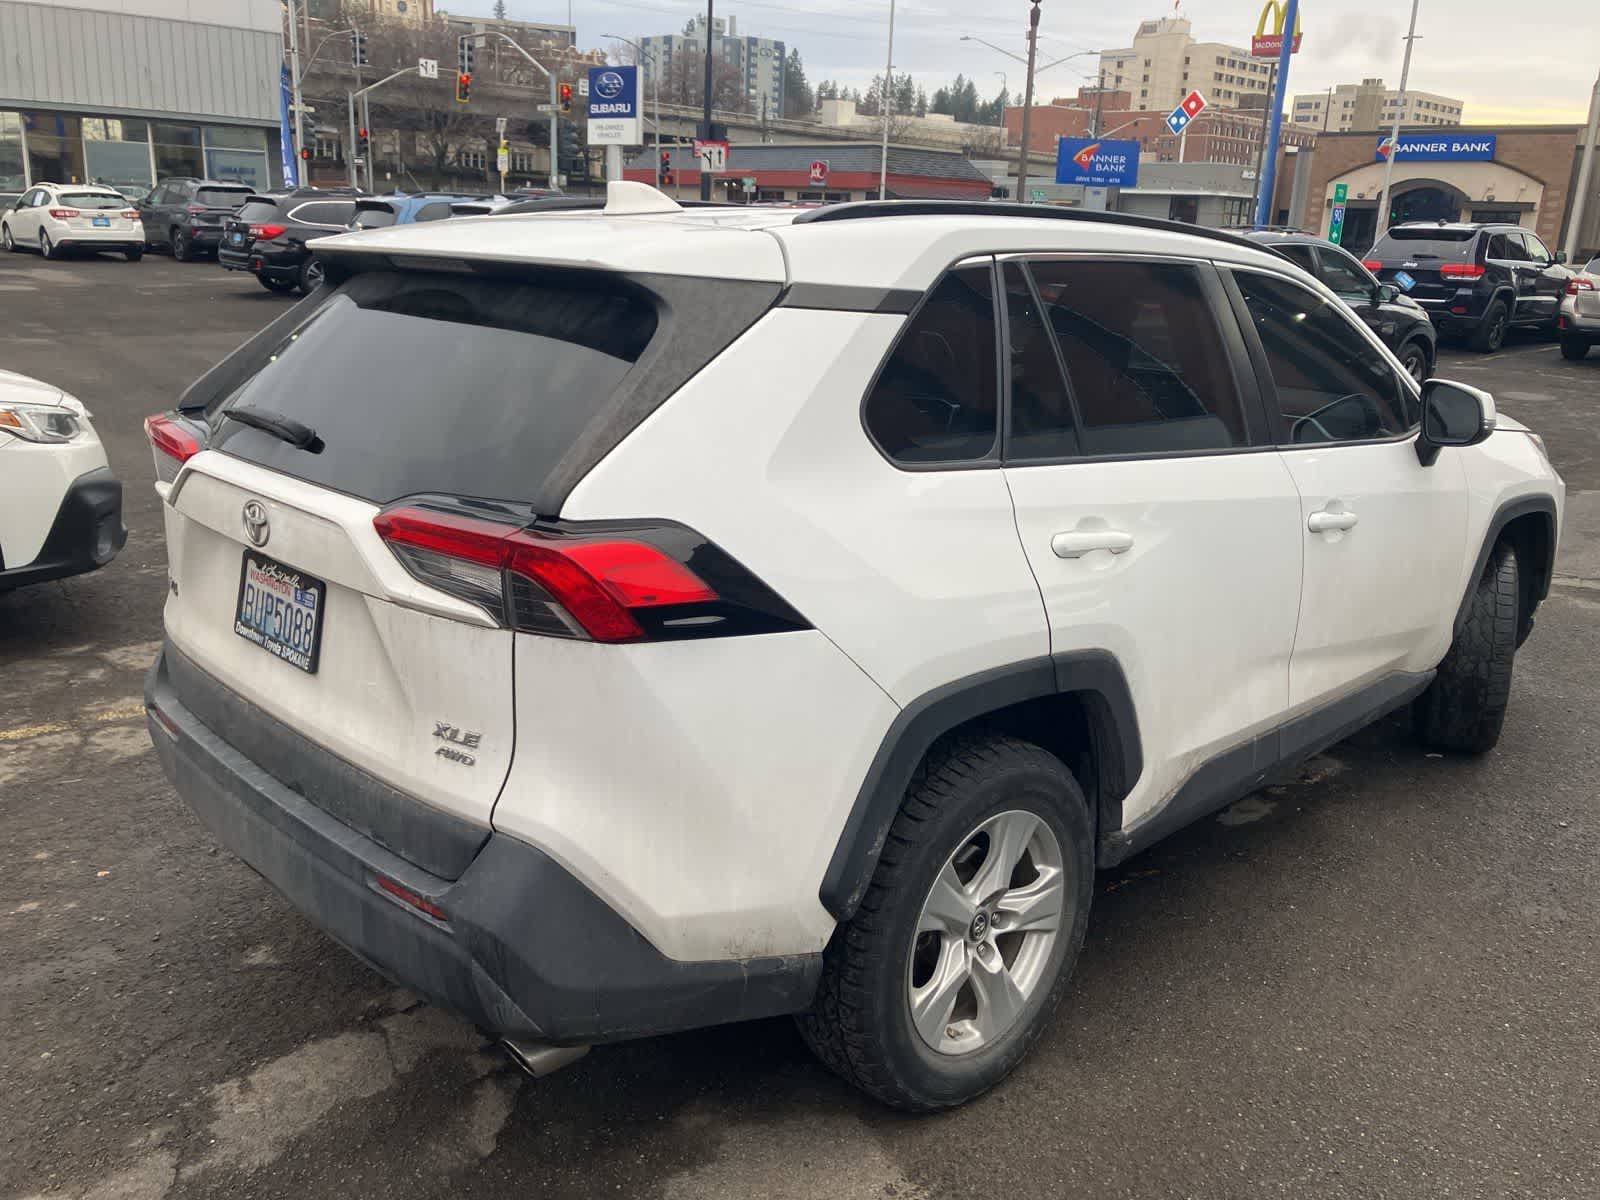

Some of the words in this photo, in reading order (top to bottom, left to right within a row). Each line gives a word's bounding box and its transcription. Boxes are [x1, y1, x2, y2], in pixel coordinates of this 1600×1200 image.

[590, 103, 631, 113] SUBARU
[1452, 142, 1491, 152] BANK
[1081, 153, 1126, 164] BANNER
[1096, 163, 1126, 173] BANK
[250, 568, 291, 596] WASHINGTON
[243, 583, 313, 653] BUP5088
[235, 621, 263, 645] Downtown
[264, 635, 281, 657] Toyota
[281, 646, 311, 670] SPOKANE
[432, 722, 482, 748] XLE
[434, 748, 476, 766] AWD
